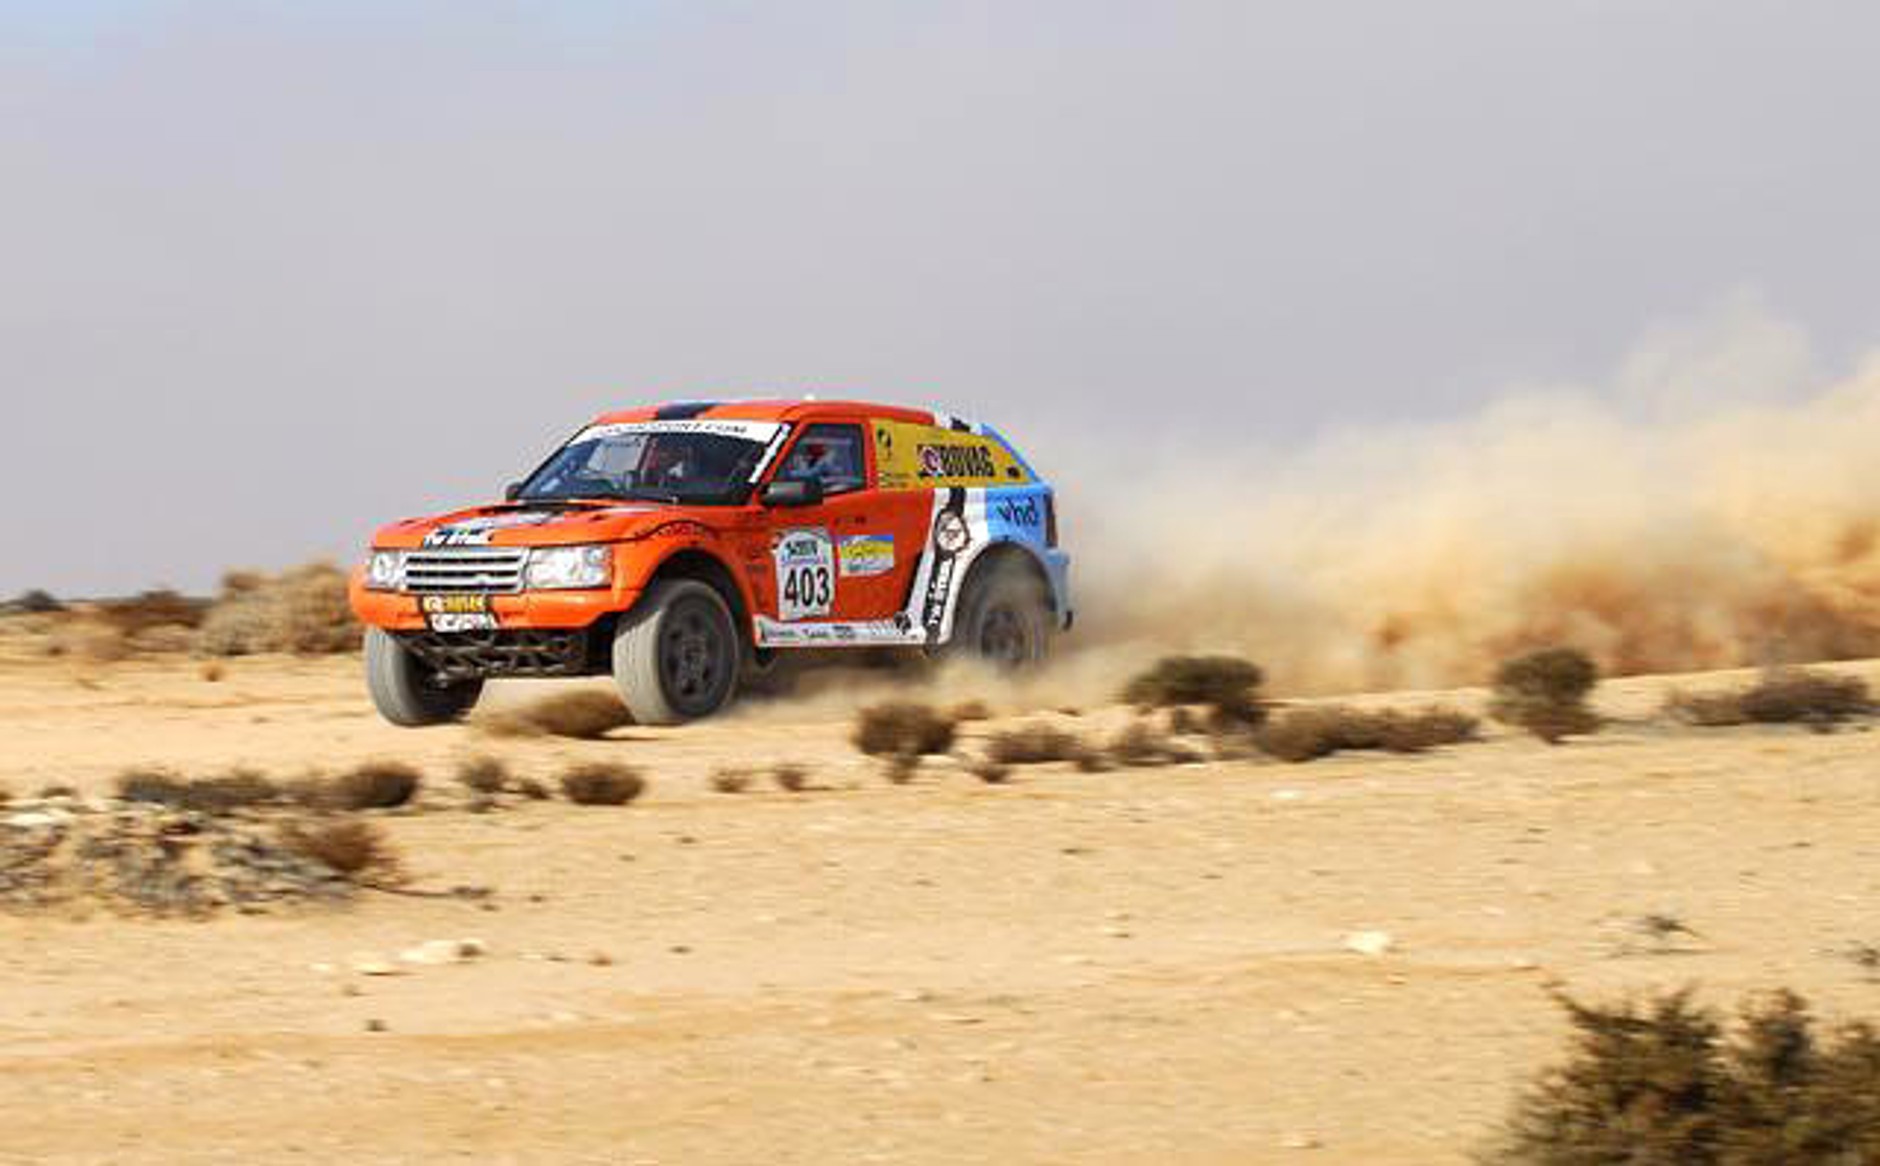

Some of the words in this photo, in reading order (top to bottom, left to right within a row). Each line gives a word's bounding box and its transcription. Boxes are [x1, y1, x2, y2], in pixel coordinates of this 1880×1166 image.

[938, 443, 996, 477] BOVAG
[997, 496, 1039, 528] vhd
[784, 566, 830, 607] 403
